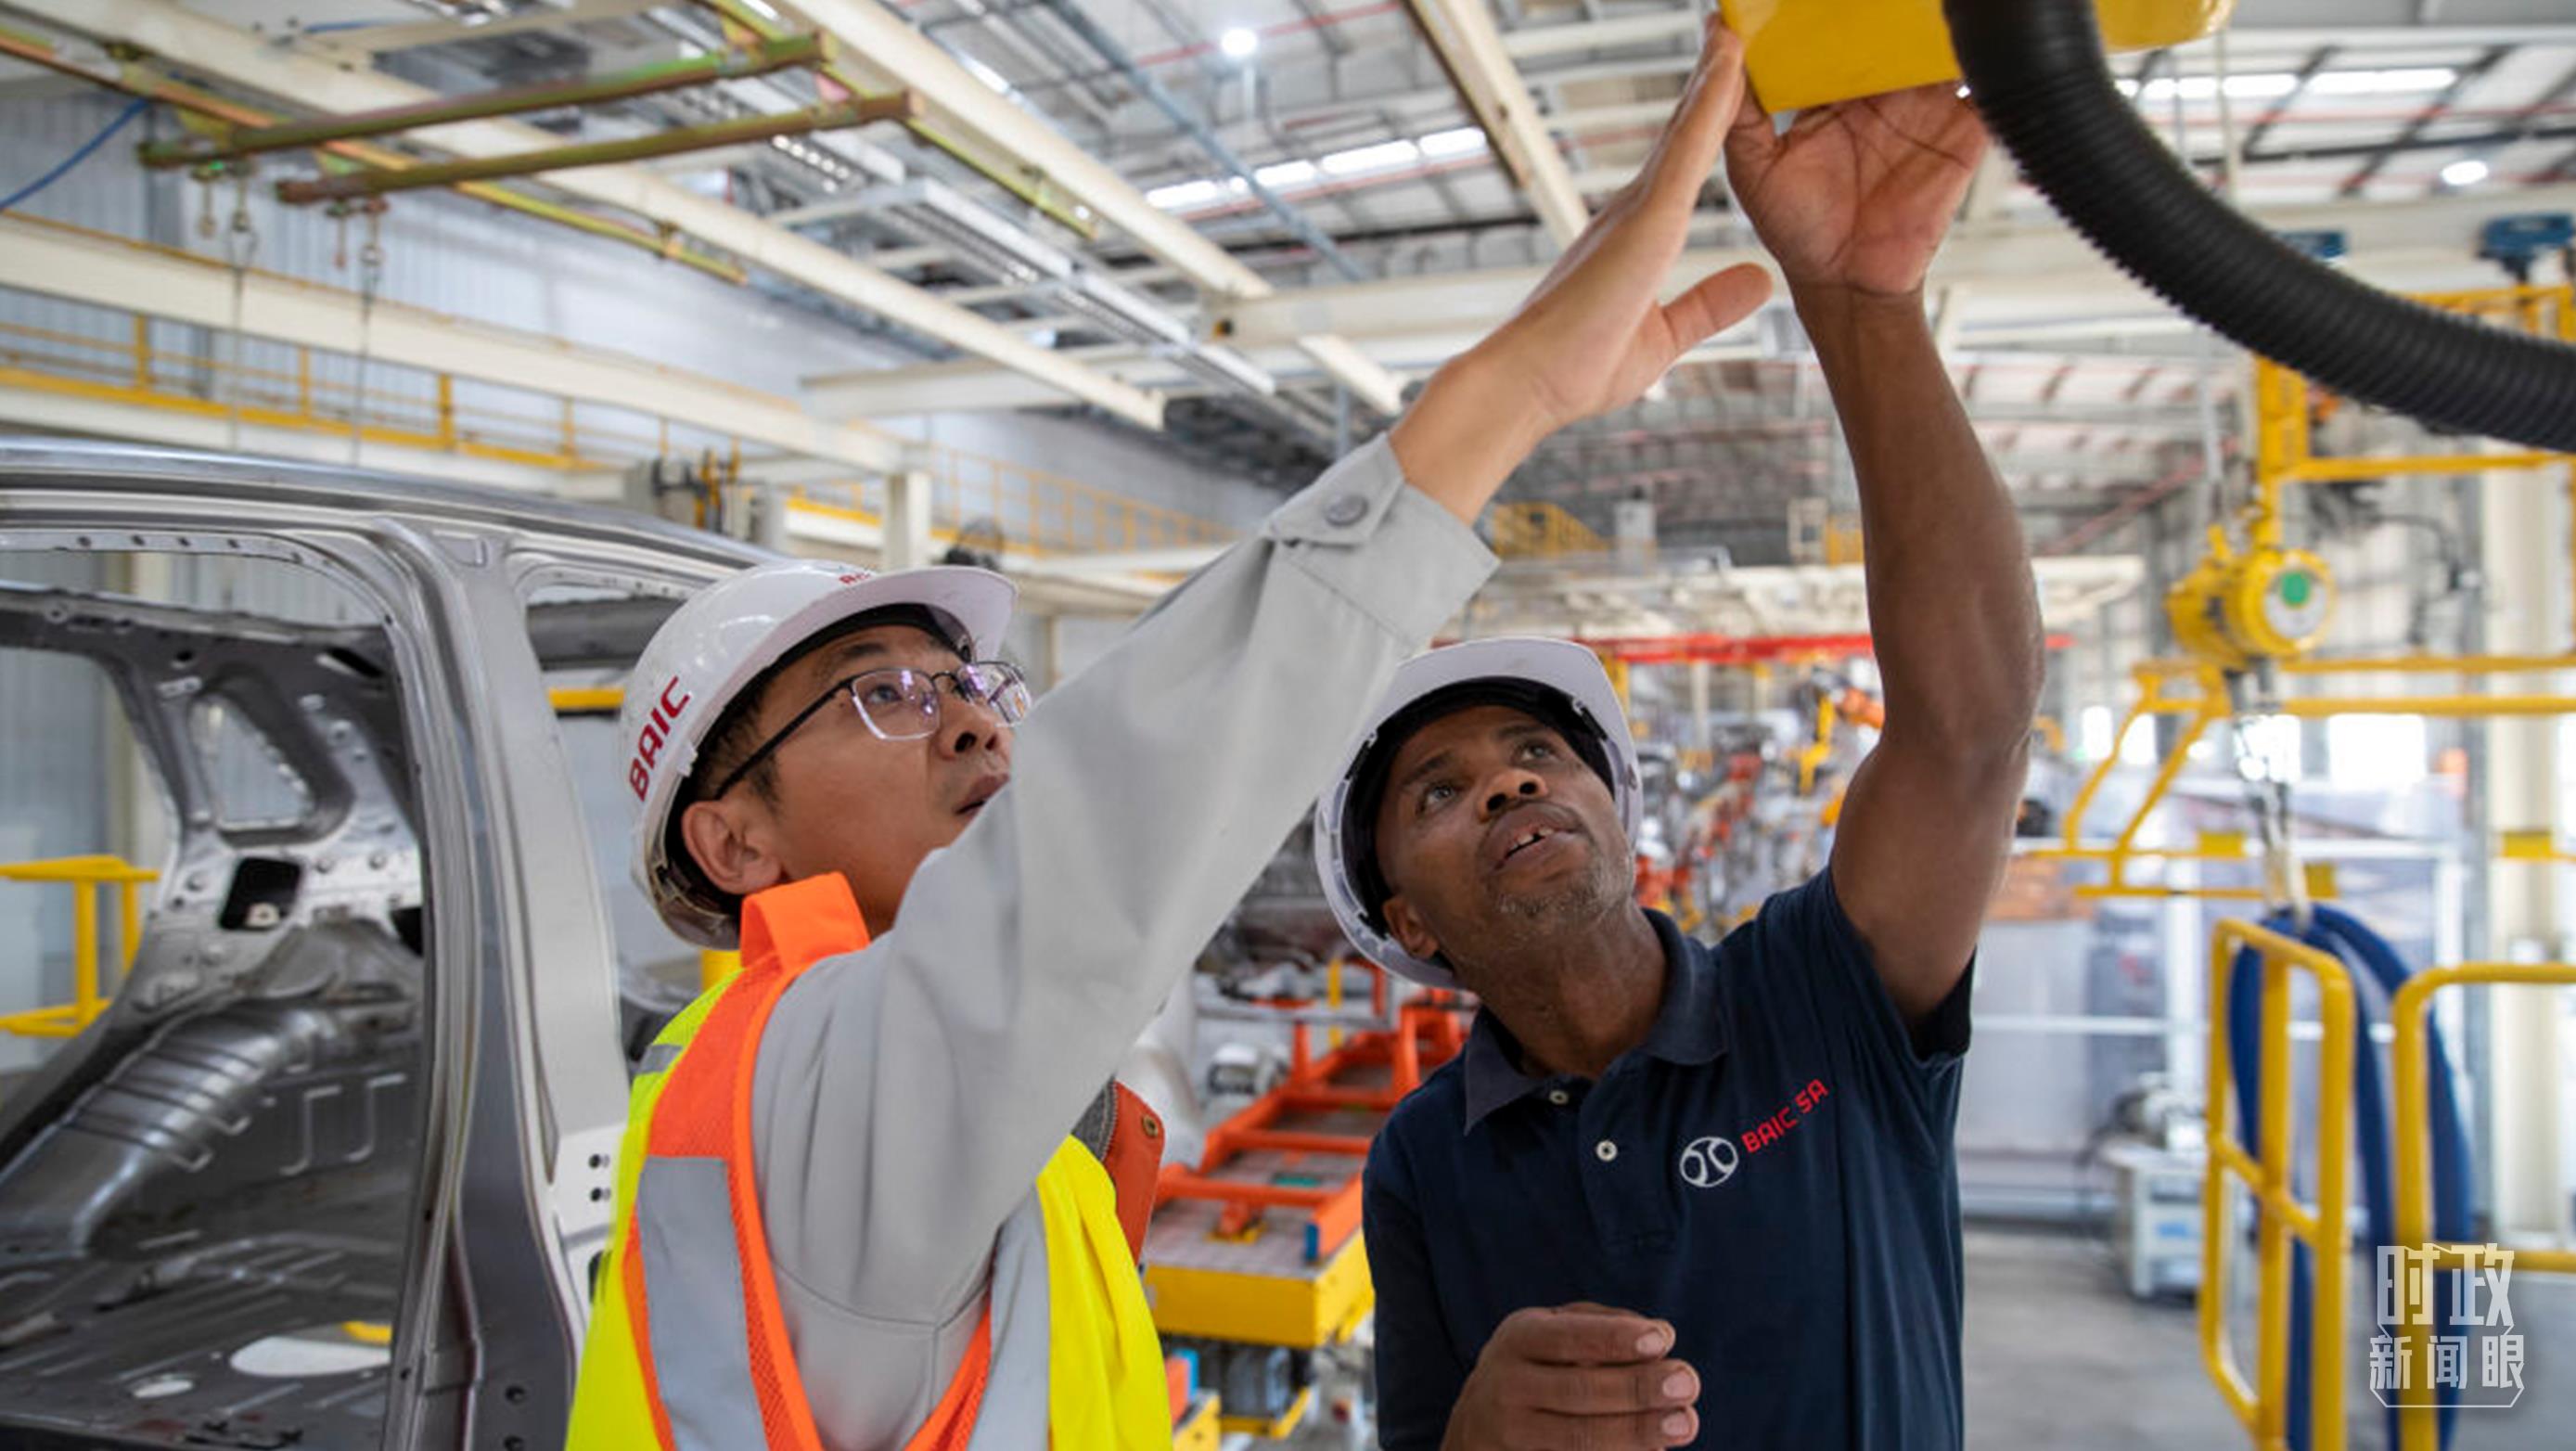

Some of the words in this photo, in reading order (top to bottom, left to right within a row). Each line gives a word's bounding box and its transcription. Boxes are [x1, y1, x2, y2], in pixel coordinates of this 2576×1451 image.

[629, 675, 691, 803] BAIC
[1741, 1106, 1798, 1153] BAIC
[1794, 1078, 1829, 1114] SA
